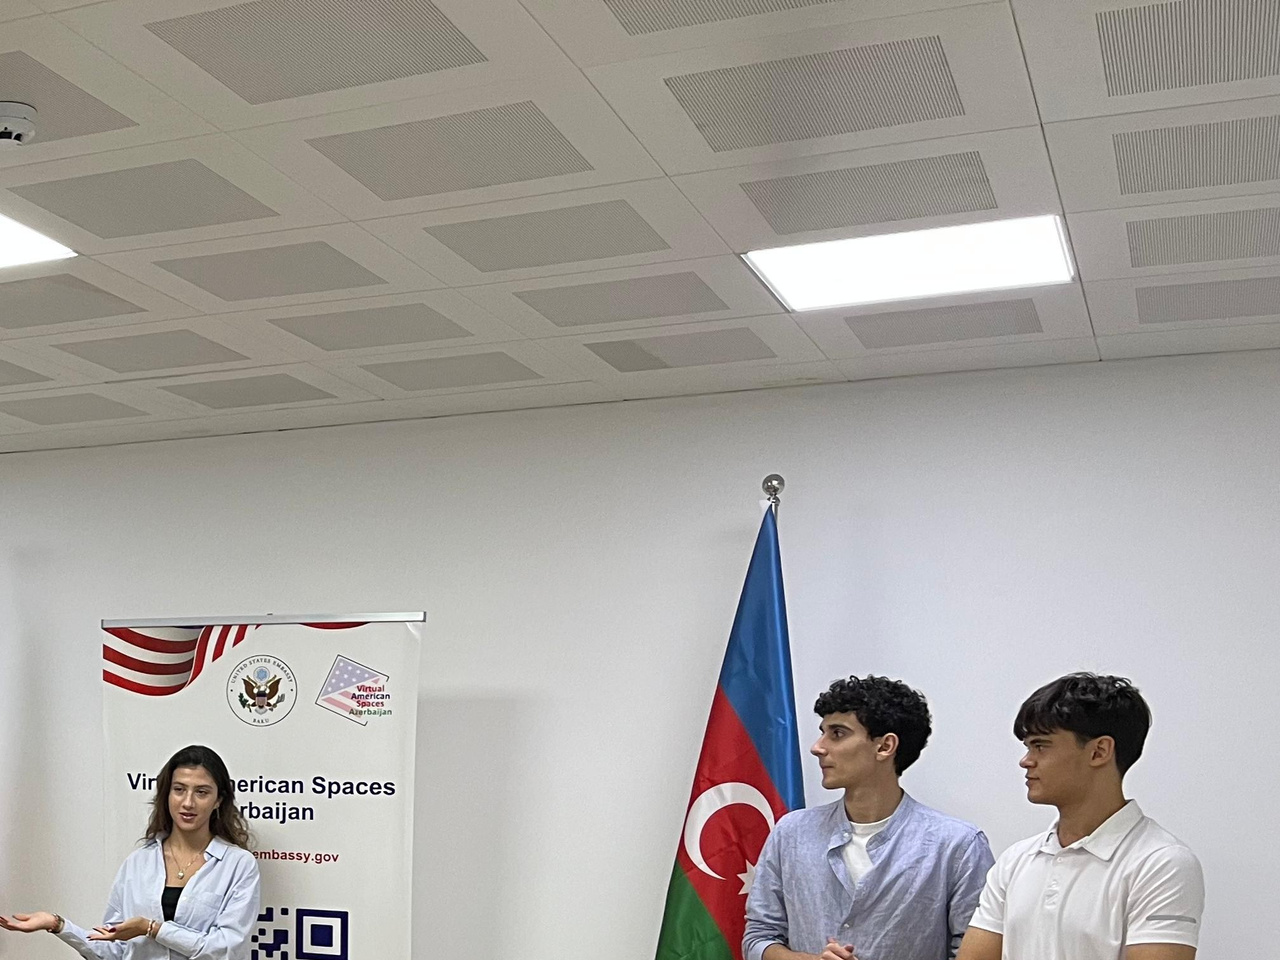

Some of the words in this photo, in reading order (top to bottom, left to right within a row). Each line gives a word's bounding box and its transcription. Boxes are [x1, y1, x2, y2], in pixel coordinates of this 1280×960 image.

[356, 684, 385, 692] Virtual
[356, 700, 385, 708] Spaces
[349, 708, 392, 717] Azerbaijan
[232, 776, 304, 795] erican
[312, 776, 396, 799] Spaces
[240, 802, 314, 825] rbaijan
[252, 849, 340, 864] embassy.gov
